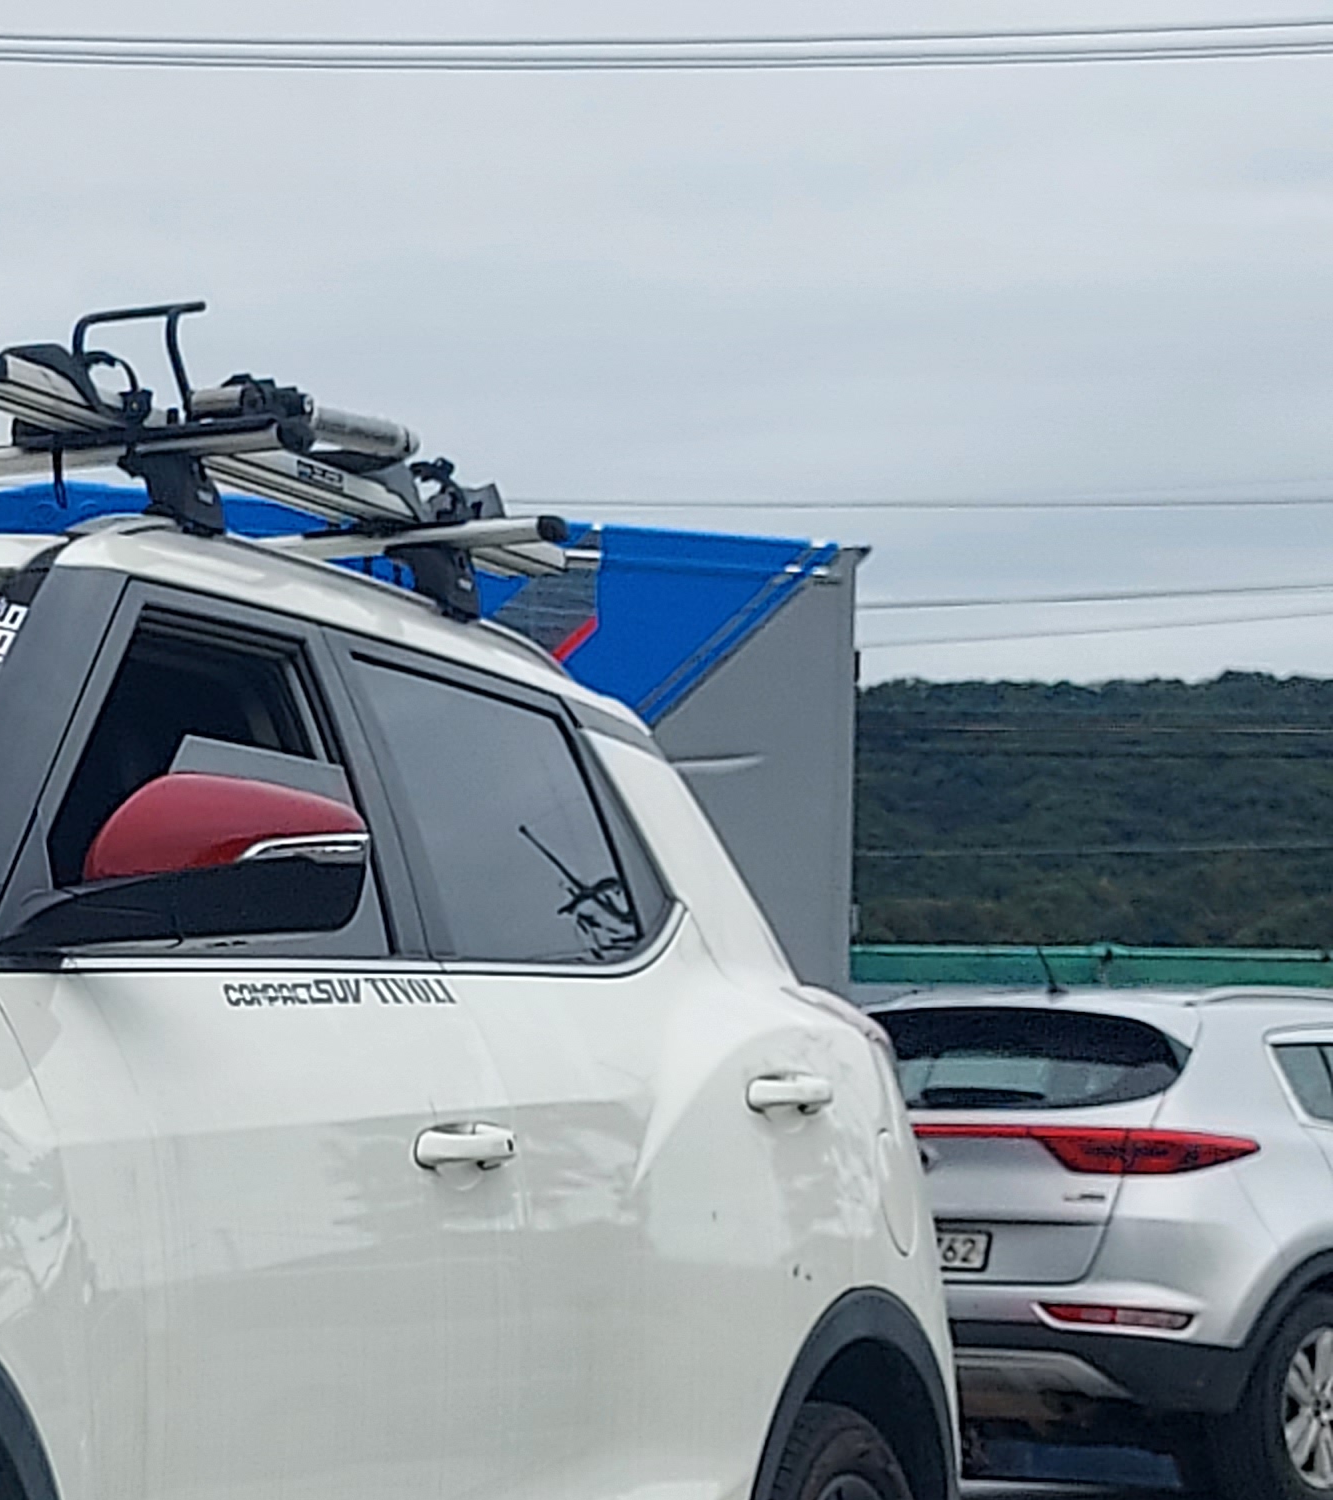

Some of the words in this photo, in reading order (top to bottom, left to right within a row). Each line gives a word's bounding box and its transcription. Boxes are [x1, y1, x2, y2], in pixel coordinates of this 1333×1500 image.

[312, 978, 363, 1004] SUV
[365, 977, 457, 1005] TIVOLI
[937, 1237, 977, 1264] 62
